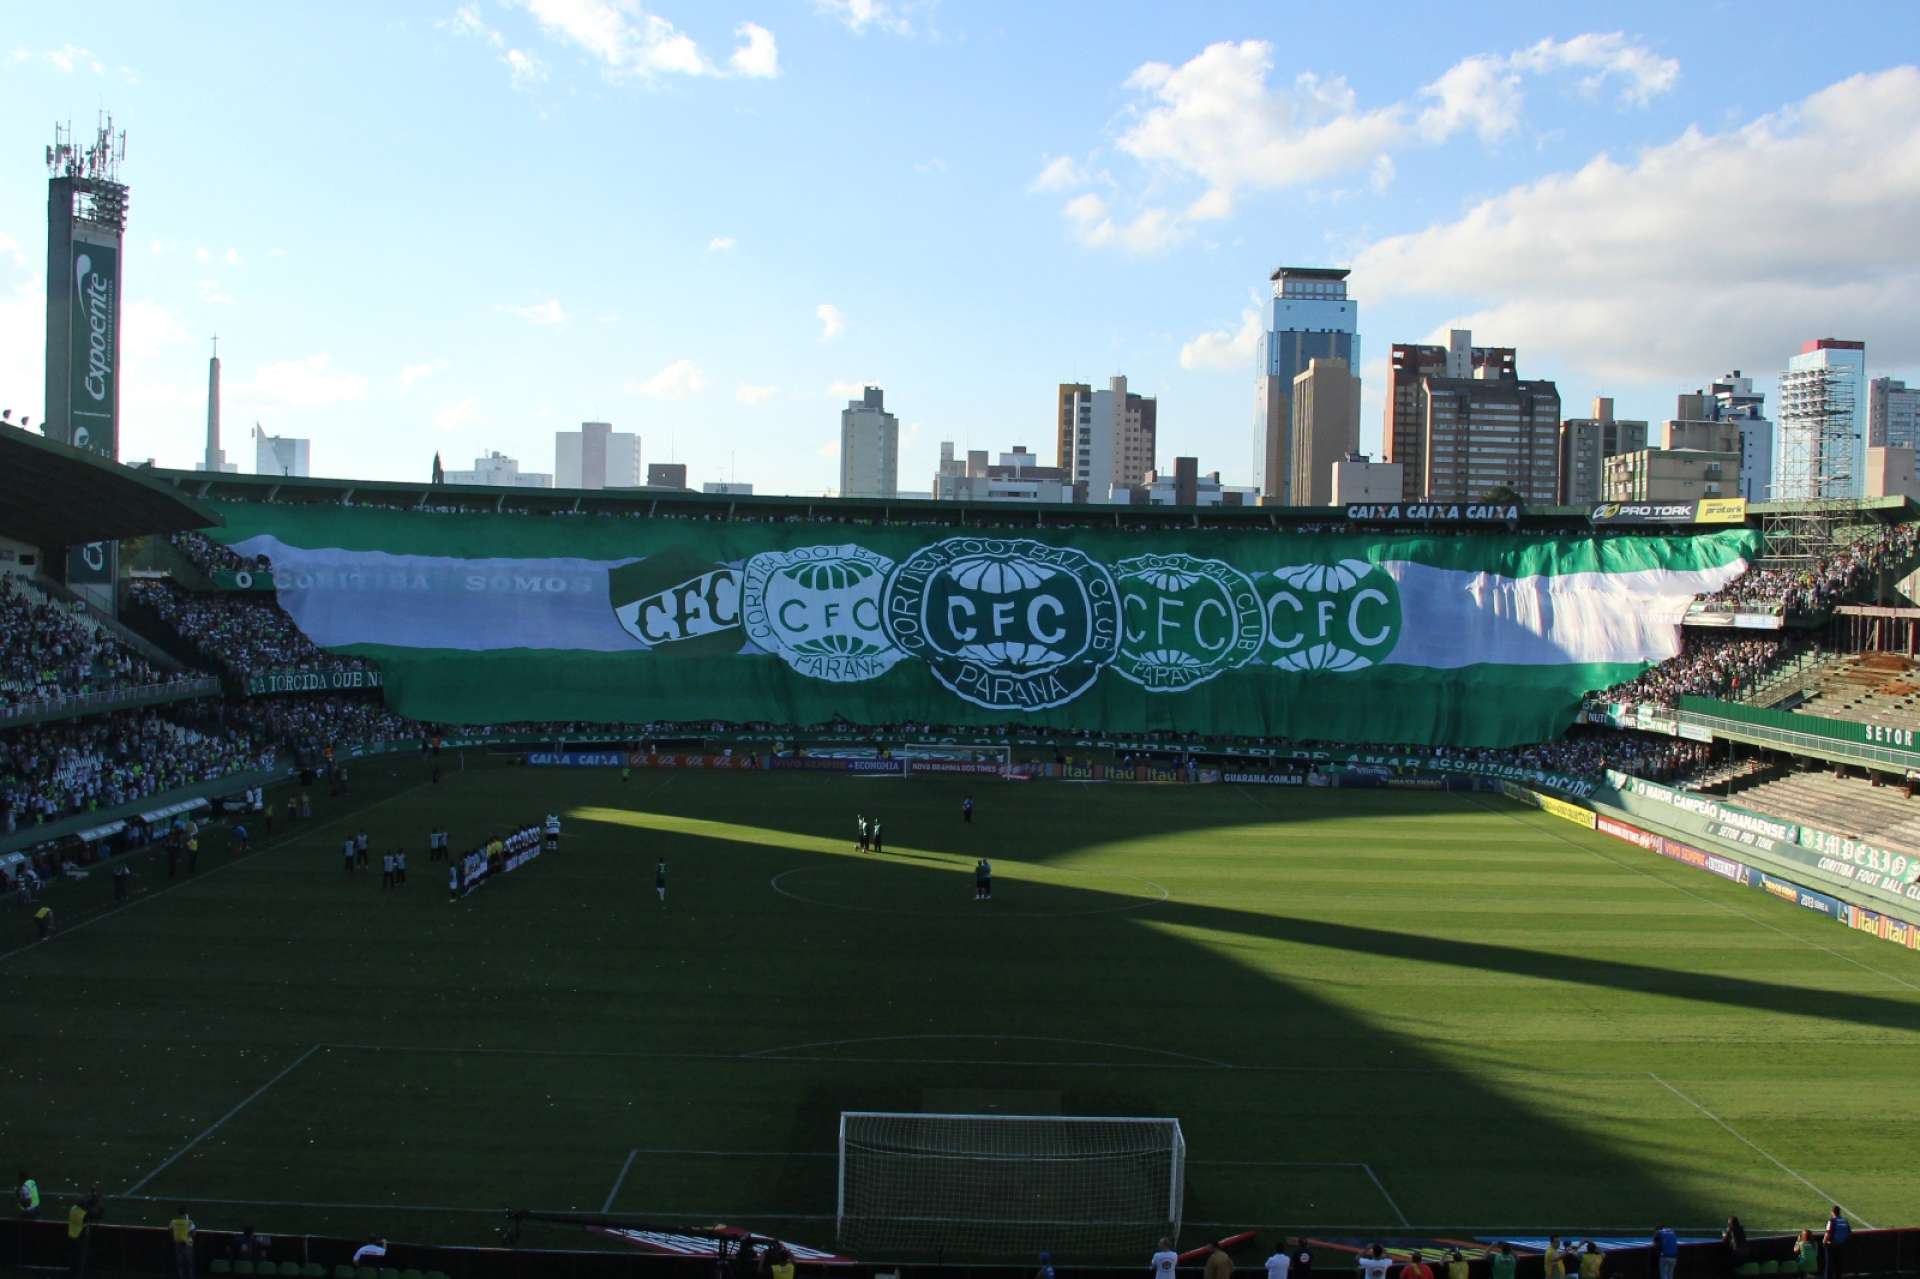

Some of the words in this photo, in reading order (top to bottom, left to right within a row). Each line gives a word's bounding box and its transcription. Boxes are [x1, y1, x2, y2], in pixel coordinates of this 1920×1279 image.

[85, 273, 111, 400] Expoente
[1347, 505, 1399, 519] CAIXA
[1406, 505, 1459, 519] CAIXA
[1466, 505, 1518, 519] CAIXA
[1618, 506, 1652, 516] PRO
[1654, 505, 1692, 516] TORK
[465, 575, 593, 592] SOMOS
[635, 570, 739, 642] CFC
[892, 551, 945, 649] CORITIBA
[1088, 578, 1113, 650] CLUB
[1236, 593, 1257, 651] CLUB
[332, 672, 362, 688] QUE
[1866, 725, 1913, 746] SETOR
[530, 753, 571, 766] CAIXA
[578, 753, 619, 766] CAIXA
[1646, 784, 1673, 804] MAIOR
[1674, 795, 1718, 818] CAMPEÃO
[1719, 809, 1786, 841] PARANAENSE
[1818, 857, 1857, 877] CORITIBA
[1855, 869, 1880, 885] FOOT
[1881, 877, 1905, 895] BALL
[1858, 910, 1880, 935] Itaú
[1886, 917, 1908, 945] Itaú
